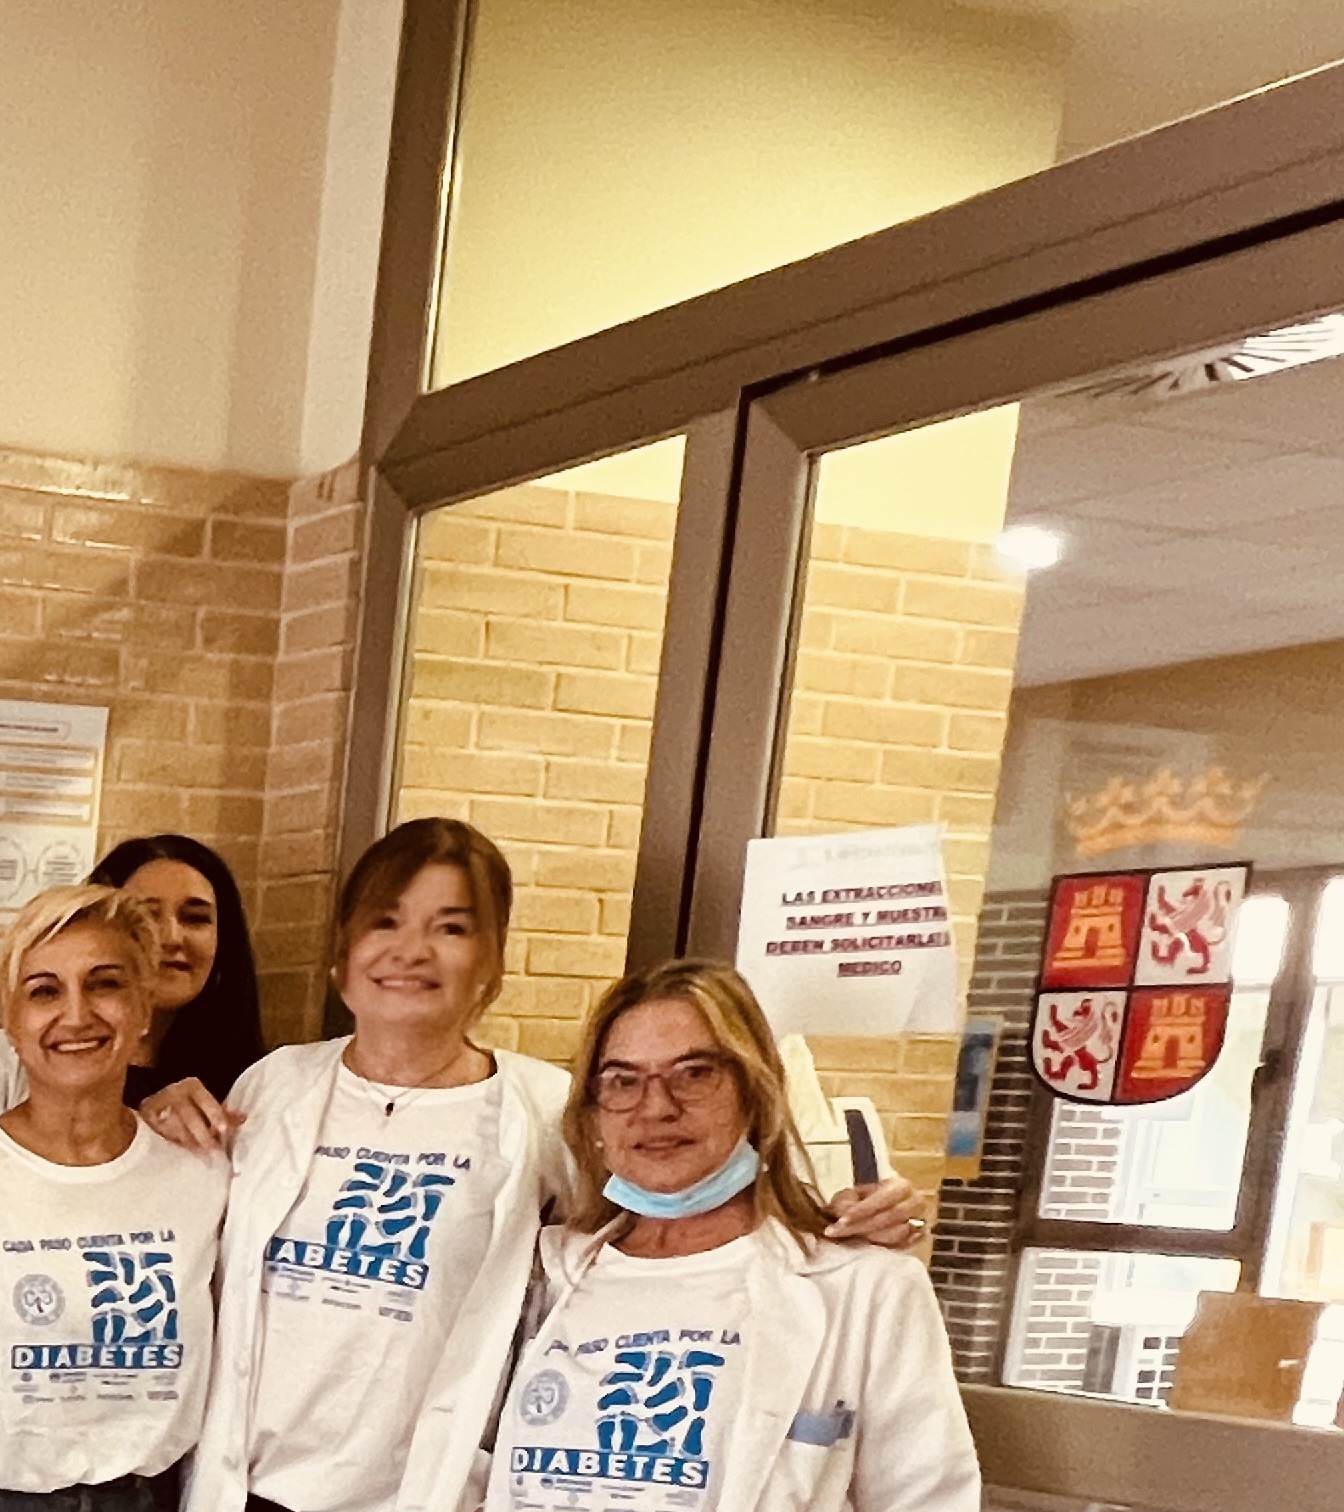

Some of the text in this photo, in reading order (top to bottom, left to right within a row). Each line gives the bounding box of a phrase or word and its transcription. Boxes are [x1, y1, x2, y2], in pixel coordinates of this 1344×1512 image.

[782, 891, 816, 905] LAS
[787, 912, 854, 930] SANGRE
[861, 912, 871, 924] Y
[766, 939, 824, 955] DEBEN
[275, 1240, 425, 1287] ABETES
[14, 1345, 181, 1368] DIABETES
[512, 1447, 705, 1486] DIABETES
